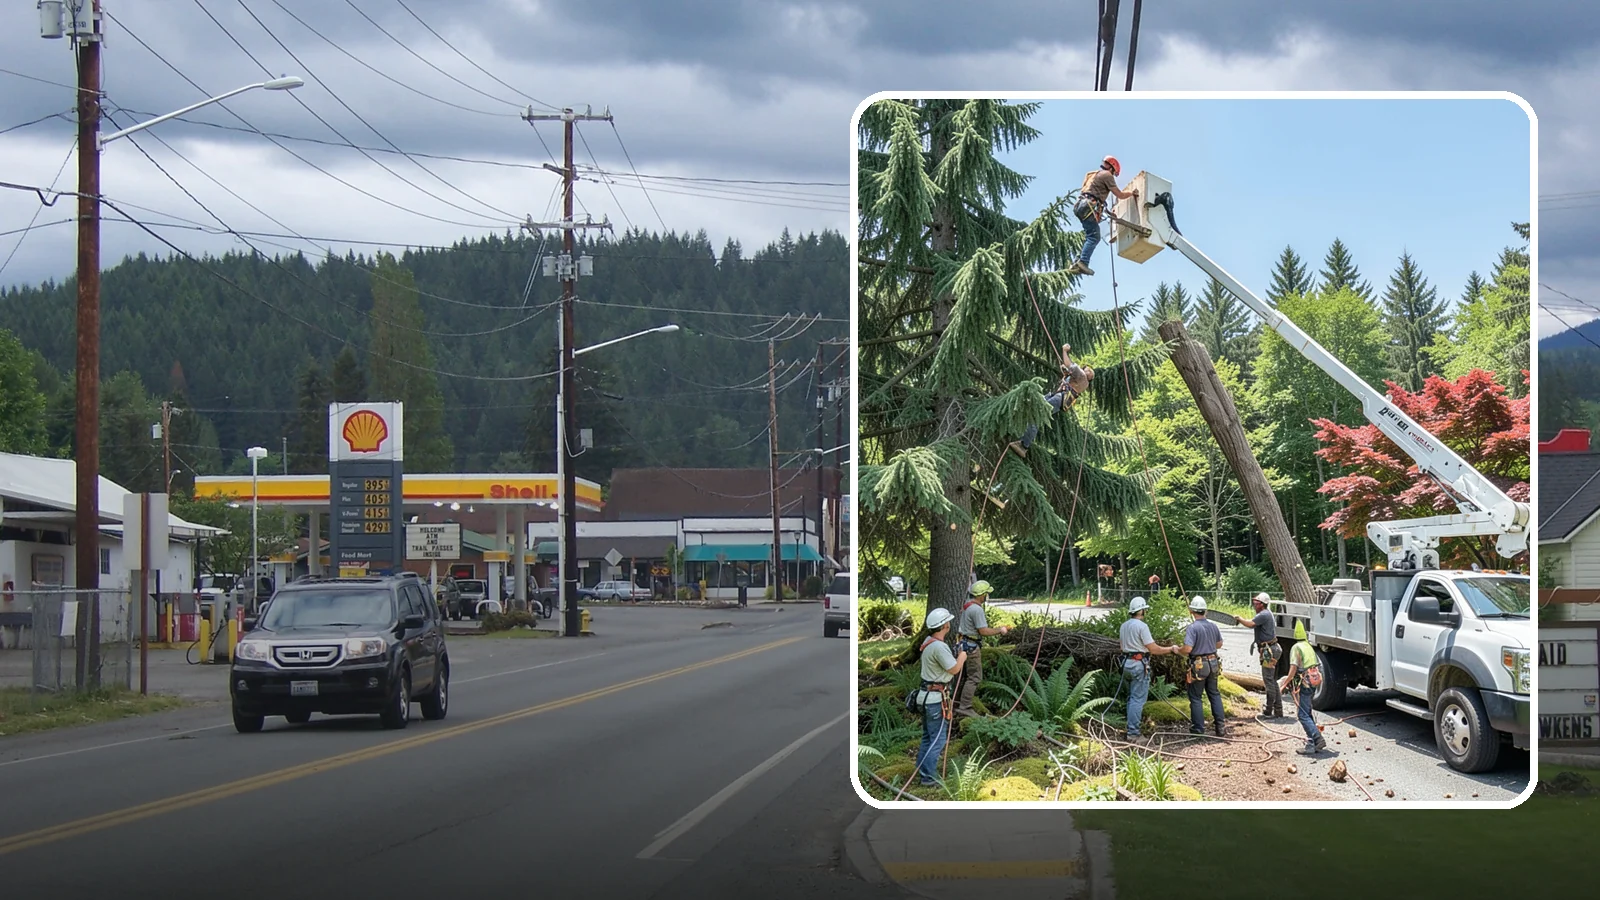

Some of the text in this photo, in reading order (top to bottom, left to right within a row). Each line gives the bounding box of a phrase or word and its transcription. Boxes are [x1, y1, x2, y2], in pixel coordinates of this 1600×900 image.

[366, 480, 383, 490] 395
[490, 484, 547, 499] Shell
[366, 494, 383, 504] 405
[366, 508, 383, 518] 415
[366, 522, 383, 532] 429
